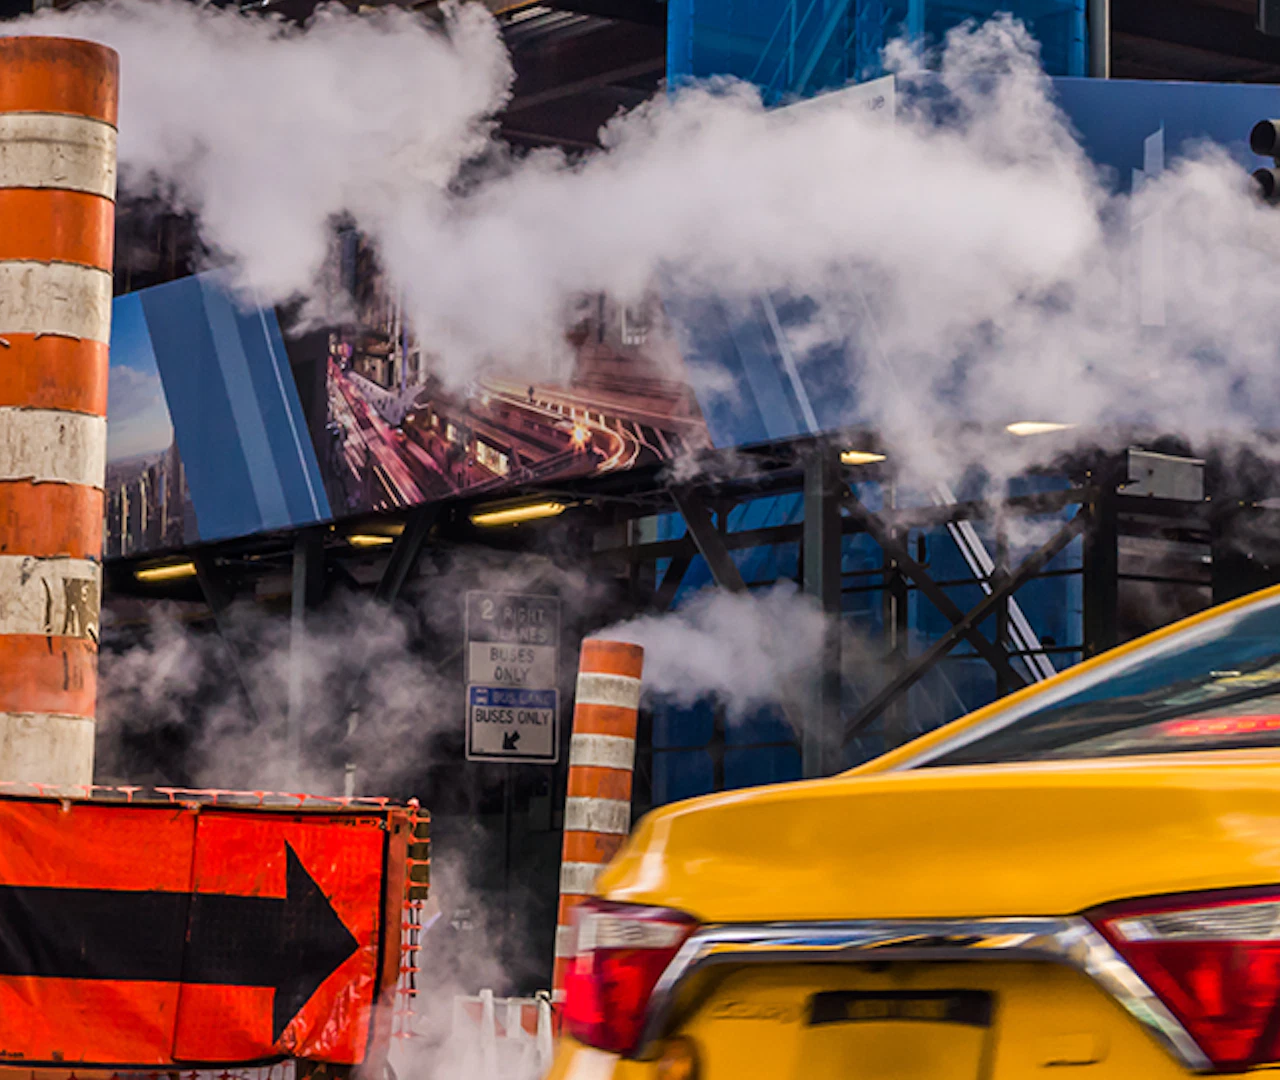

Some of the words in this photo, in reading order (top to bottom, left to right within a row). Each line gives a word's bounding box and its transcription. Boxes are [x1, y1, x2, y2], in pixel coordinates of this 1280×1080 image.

[481, 598, 494, 620] 2
[502, 605, 545, 624] RIGHT
[497, 625, 548, 643] LANES
[489, 646, 535, 663] BUSES
[494, 664, 531, 682] ONLY
[475, 708, 515, 724] BUSES
[518, 710, 550, 726] ONLY
